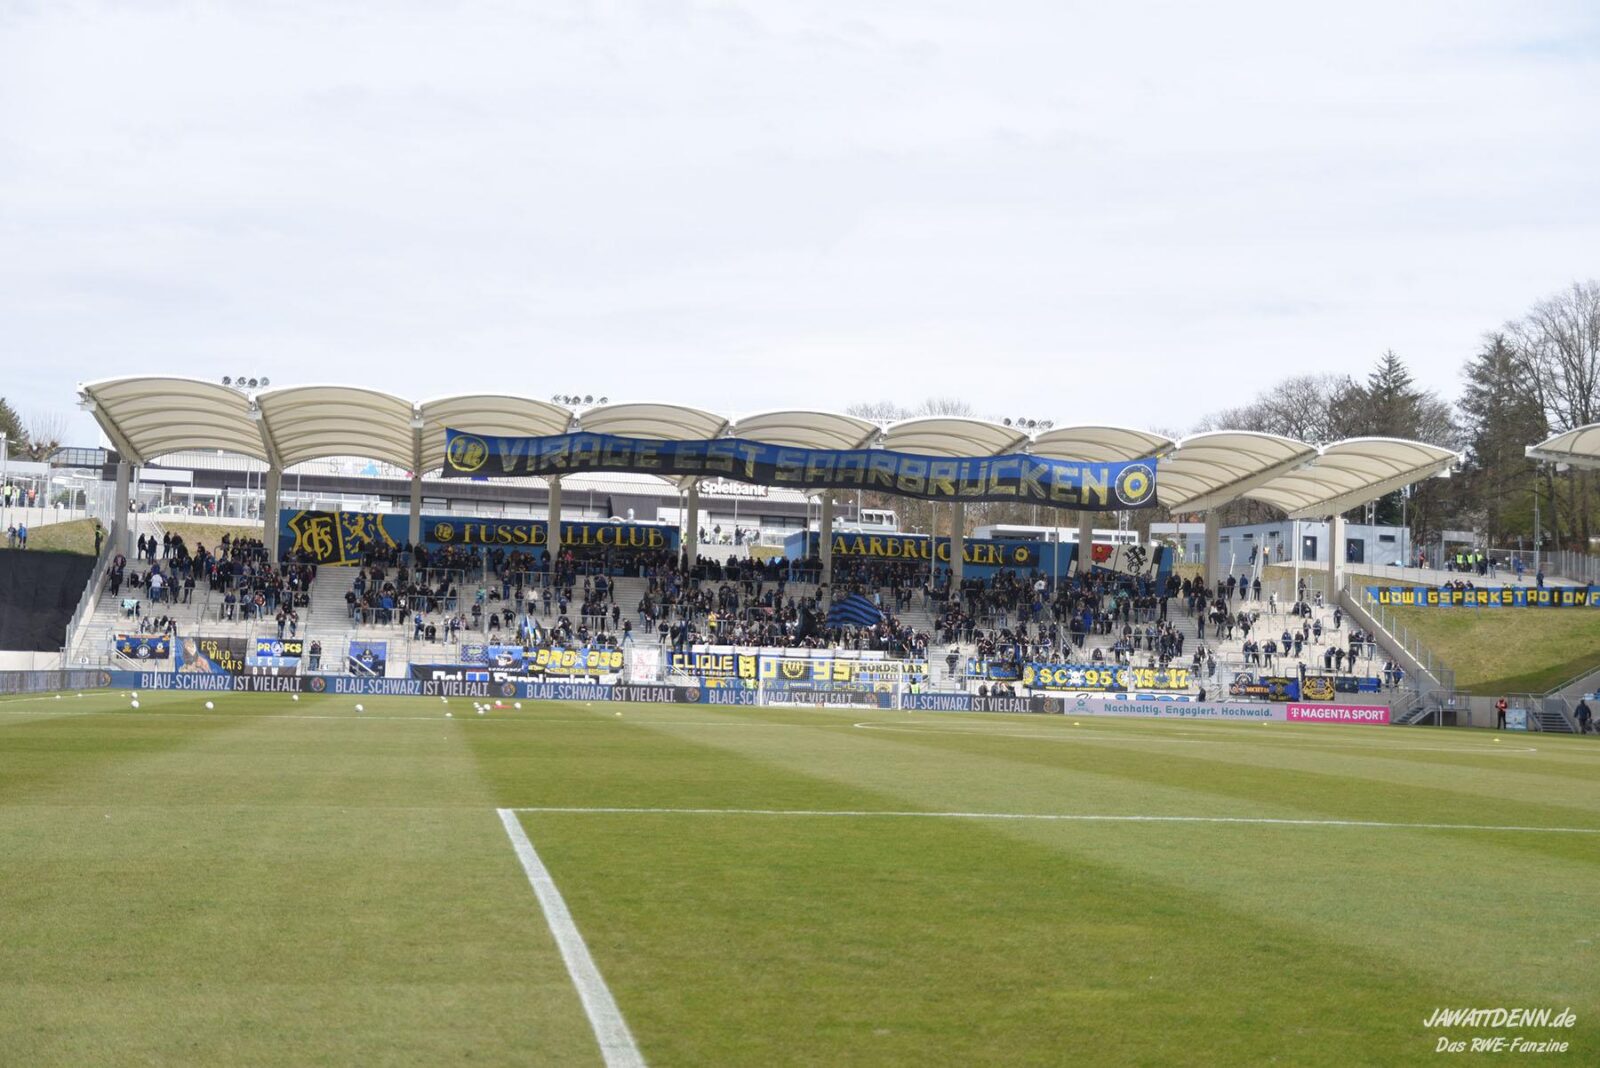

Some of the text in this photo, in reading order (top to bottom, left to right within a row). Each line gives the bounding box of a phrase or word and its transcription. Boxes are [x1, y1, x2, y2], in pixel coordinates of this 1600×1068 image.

[500, 433, 662, 473] VIRAGE
[674, 440, 766, 479] EST
[701, 477, 767, 496] Spielbank
[463, 523, 664, 548] FUSSBLLCLUB
[201, 640, 218, 651] FCS
[284, 643, 302, 653] FCS
[209, 650, 231, 660] WILD
[672, 653, 734, 670] CLIQUE
[221, 659, 242, 670] CATS
[141, 673, 303, 692] BLAU-SCHWARZ IST VIELFALT.
[1085, 670, 1113, 685] 95
[1169, 669, 1187, 689] 17
[335, 678, 490, 697] BLAU-SCHWARZ IST VIELFALT.
[526, 684, 676, 702] BLAU-SCHWARZ IST VIELFALT.
[792, 690, 806, 703] IST
[971, 696, 986, 711] IST
[988, 697, 1032, 713] VIELFALT.
[1104, 703, 1162, 716] Nachhaltig.
[1166, 705, 1218, 717] Engagiert.
[1221, 706, 1273, 717] Hochwald.
[1301, 708, 1350, 719] MAGENTA
[1352, 709, 1385, 720] SPORT
